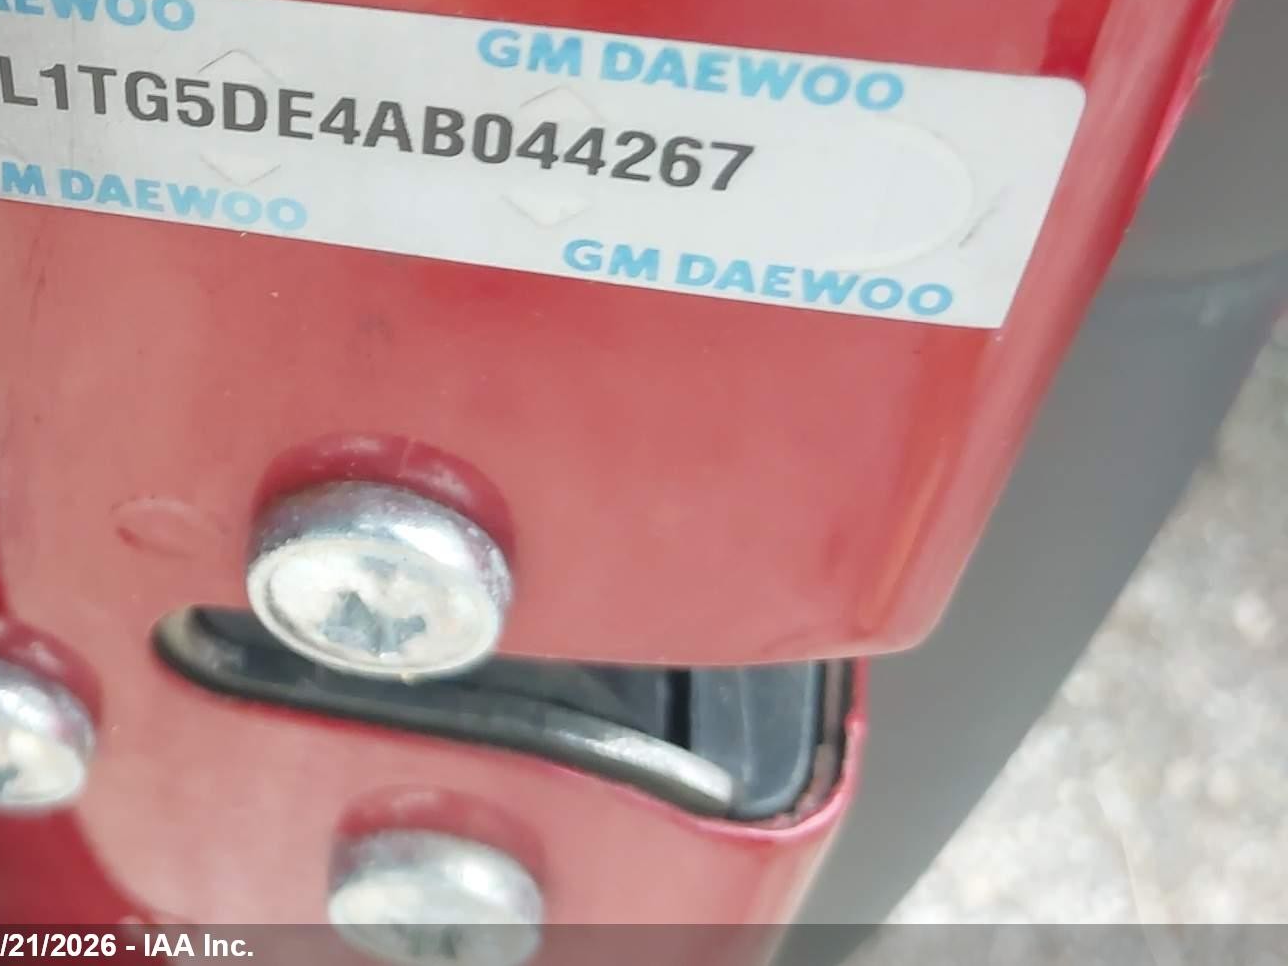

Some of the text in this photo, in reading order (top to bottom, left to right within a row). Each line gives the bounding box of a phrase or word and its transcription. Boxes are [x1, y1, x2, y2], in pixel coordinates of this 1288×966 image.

[478, 28, 905, 112] GM DAEWOO
[59, 169, 308, 232] DAEWOO
[563, 238, 954, 317] GM DAEWOO
